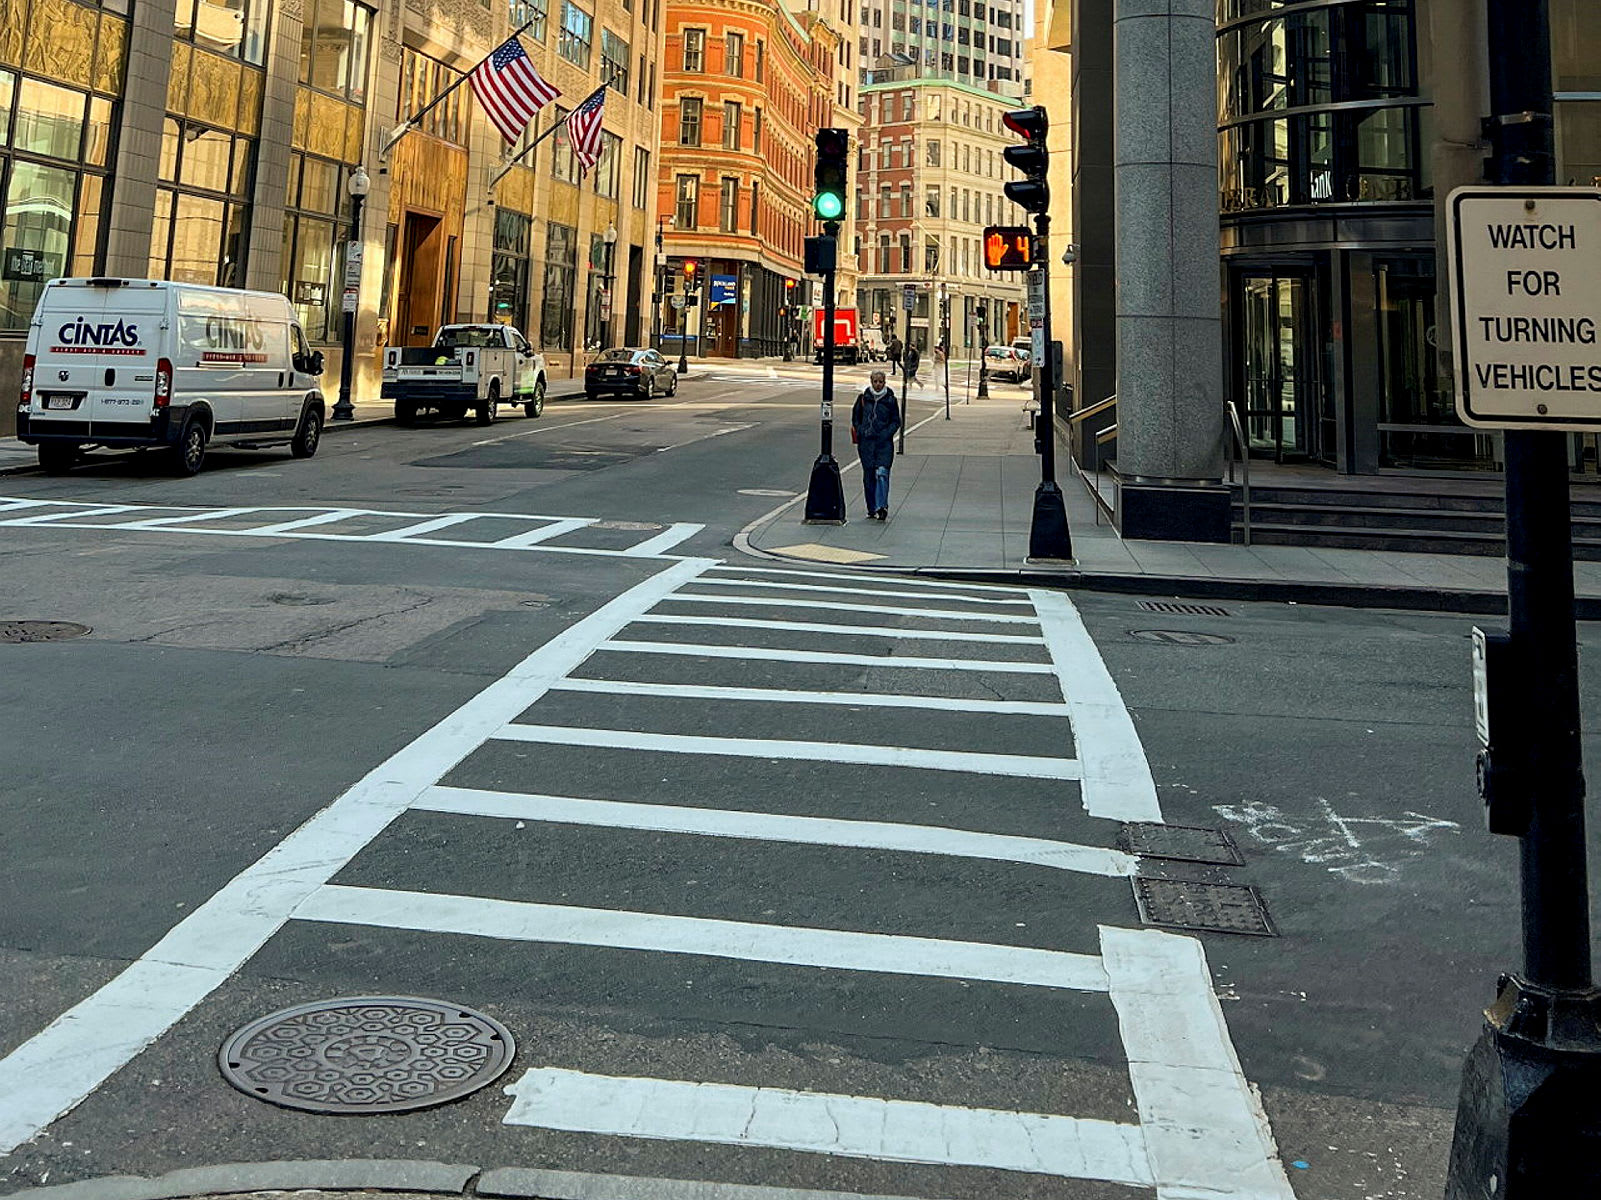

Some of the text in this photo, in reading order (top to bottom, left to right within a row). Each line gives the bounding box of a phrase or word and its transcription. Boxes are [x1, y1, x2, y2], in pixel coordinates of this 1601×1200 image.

[1016, 236, 1029, 262] 4
[1488, 224, 1576, 249] WATCH
[1507, 270, 1560, 296] FOR
[1479, 317, 1596, 344] TURNING
[1475, 363, 1601, 392] VEHICLES
